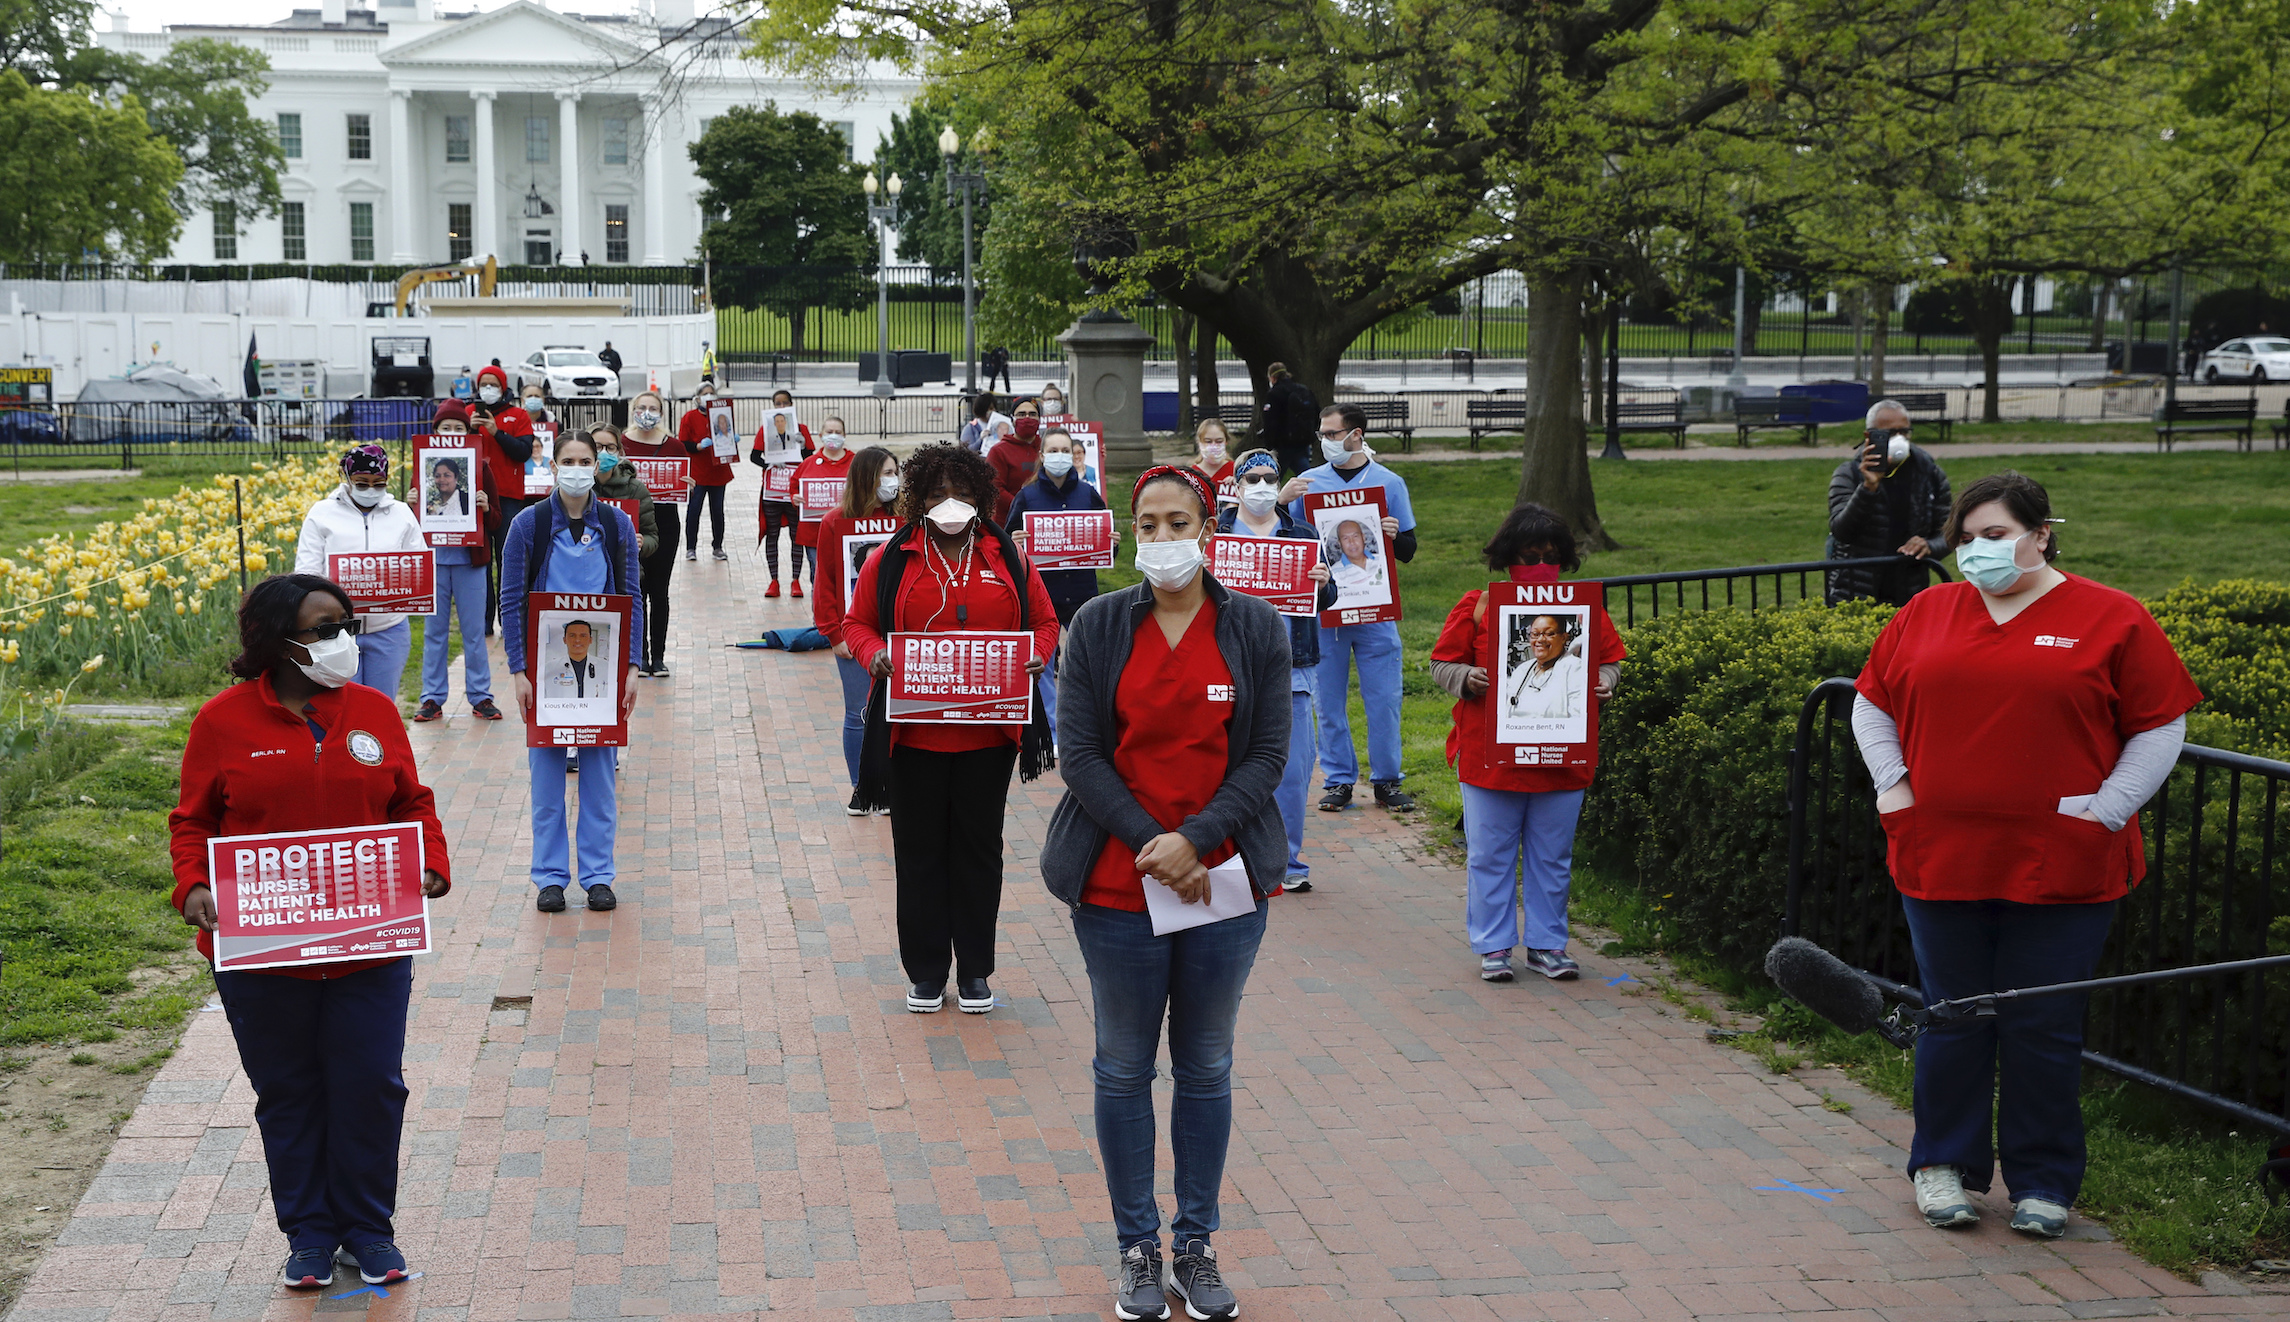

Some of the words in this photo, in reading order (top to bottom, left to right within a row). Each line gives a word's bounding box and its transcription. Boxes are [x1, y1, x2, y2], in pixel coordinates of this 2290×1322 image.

[1040, 415, 1064, 423] NNU
[531, 423, 546, 431] NU
[429, 436, 465, 448] NNU
[632, 461, 682, 471] ROTECT
[1323, 491, 1365, 507] NNU
[855, 519, 896, 533] NNU
[1034, 516, 1103, 528] PROTECT
[1215, 540, 1307, 560] PROTECT
[338, 555, 423, 570] PROTECT
[1214, 560, 1255, 570] NURSES
[339, 573, 377, 582] NURSES
[1214, 569, 1262, 580] PATIENTS
[1252, 581, 1292, 591] HEALTH
[375, 588, 412, 596] HEALTH
[1516, 585, 1574, 603] NNU
[555, 595, 607, 609] NNU
[905, 638, 1018, 657] PROTECT
[904, 663, 954, 672] NURSES
[904, 674, 965, 684] PATIENTS
[904, 685, 949, 694] PUBLIC
[952, 686, 1001, 694] HEALTH
[562, 702, 578, 710] Kelly,
[235, 836, 399, 873] PROTECT
[237, 878, 311, 896] NURSES
[238, 892, 326, 911] PATIENTS
[239, 910, 305, 928] PUBLIC
[310, 904, 381, 922] HEALTH
[376, 927, 421, 937] #COVID19
